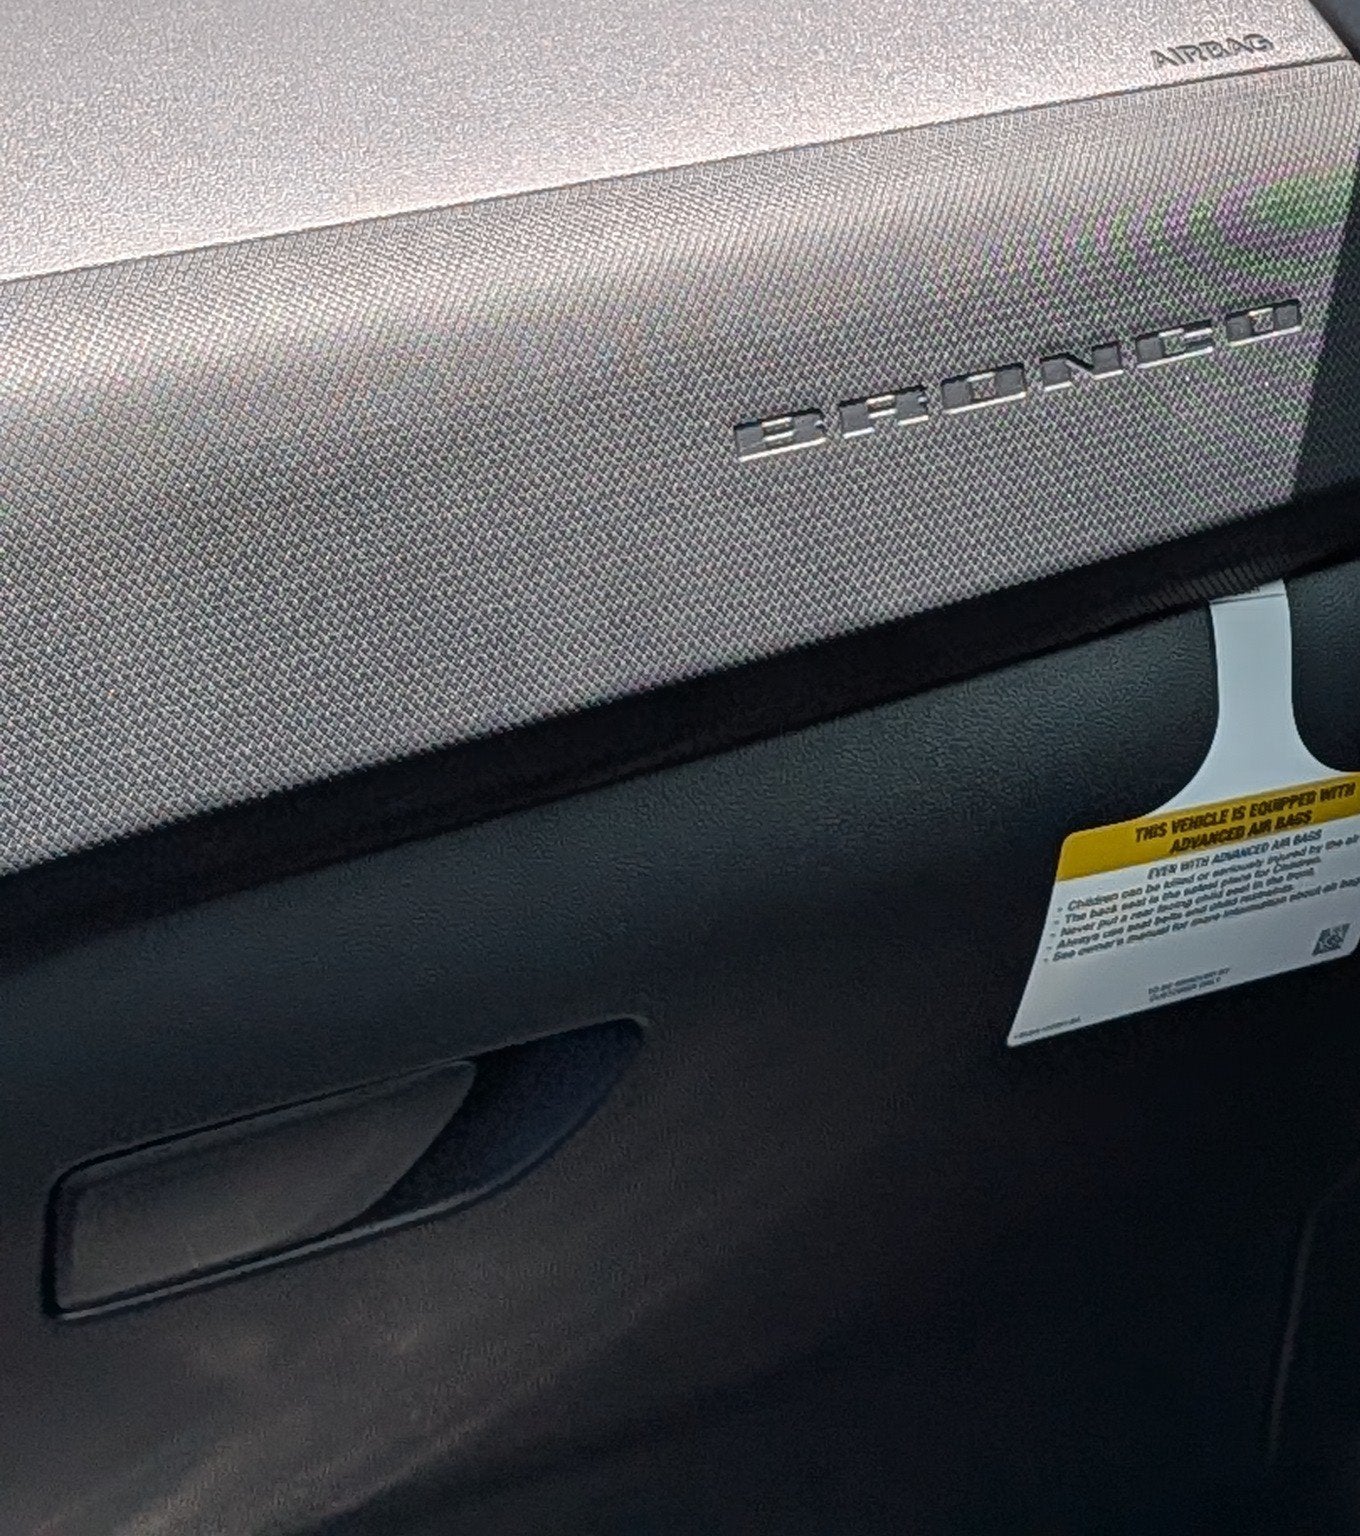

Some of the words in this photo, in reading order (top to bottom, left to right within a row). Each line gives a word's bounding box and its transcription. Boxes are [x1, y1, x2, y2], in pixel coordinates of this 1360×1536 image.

[1150, 33, 1275, 69] AIRBAG
[733, 298, 1303, 462] BRONCO
[1135, 822, 1167, 842] THIS
[1172, 809, 1229, 834] VEHICLE
[1231, 805, 1247, 821] IS
[1249, 791, 1316, 817] EQUIPPED
[1320, 782, 1356, 802] WITH
[1169, 826, 1245, 854] ADVANCED
[1247, 819, 1272, 836] AIR
[1274, 810, 1312, 829] BAGS
[1212, 842, 1269, 863] ADVANCED
[1271, 837, 1291, 850] AIR
[1293, 829, 1322, 844] BAGS
